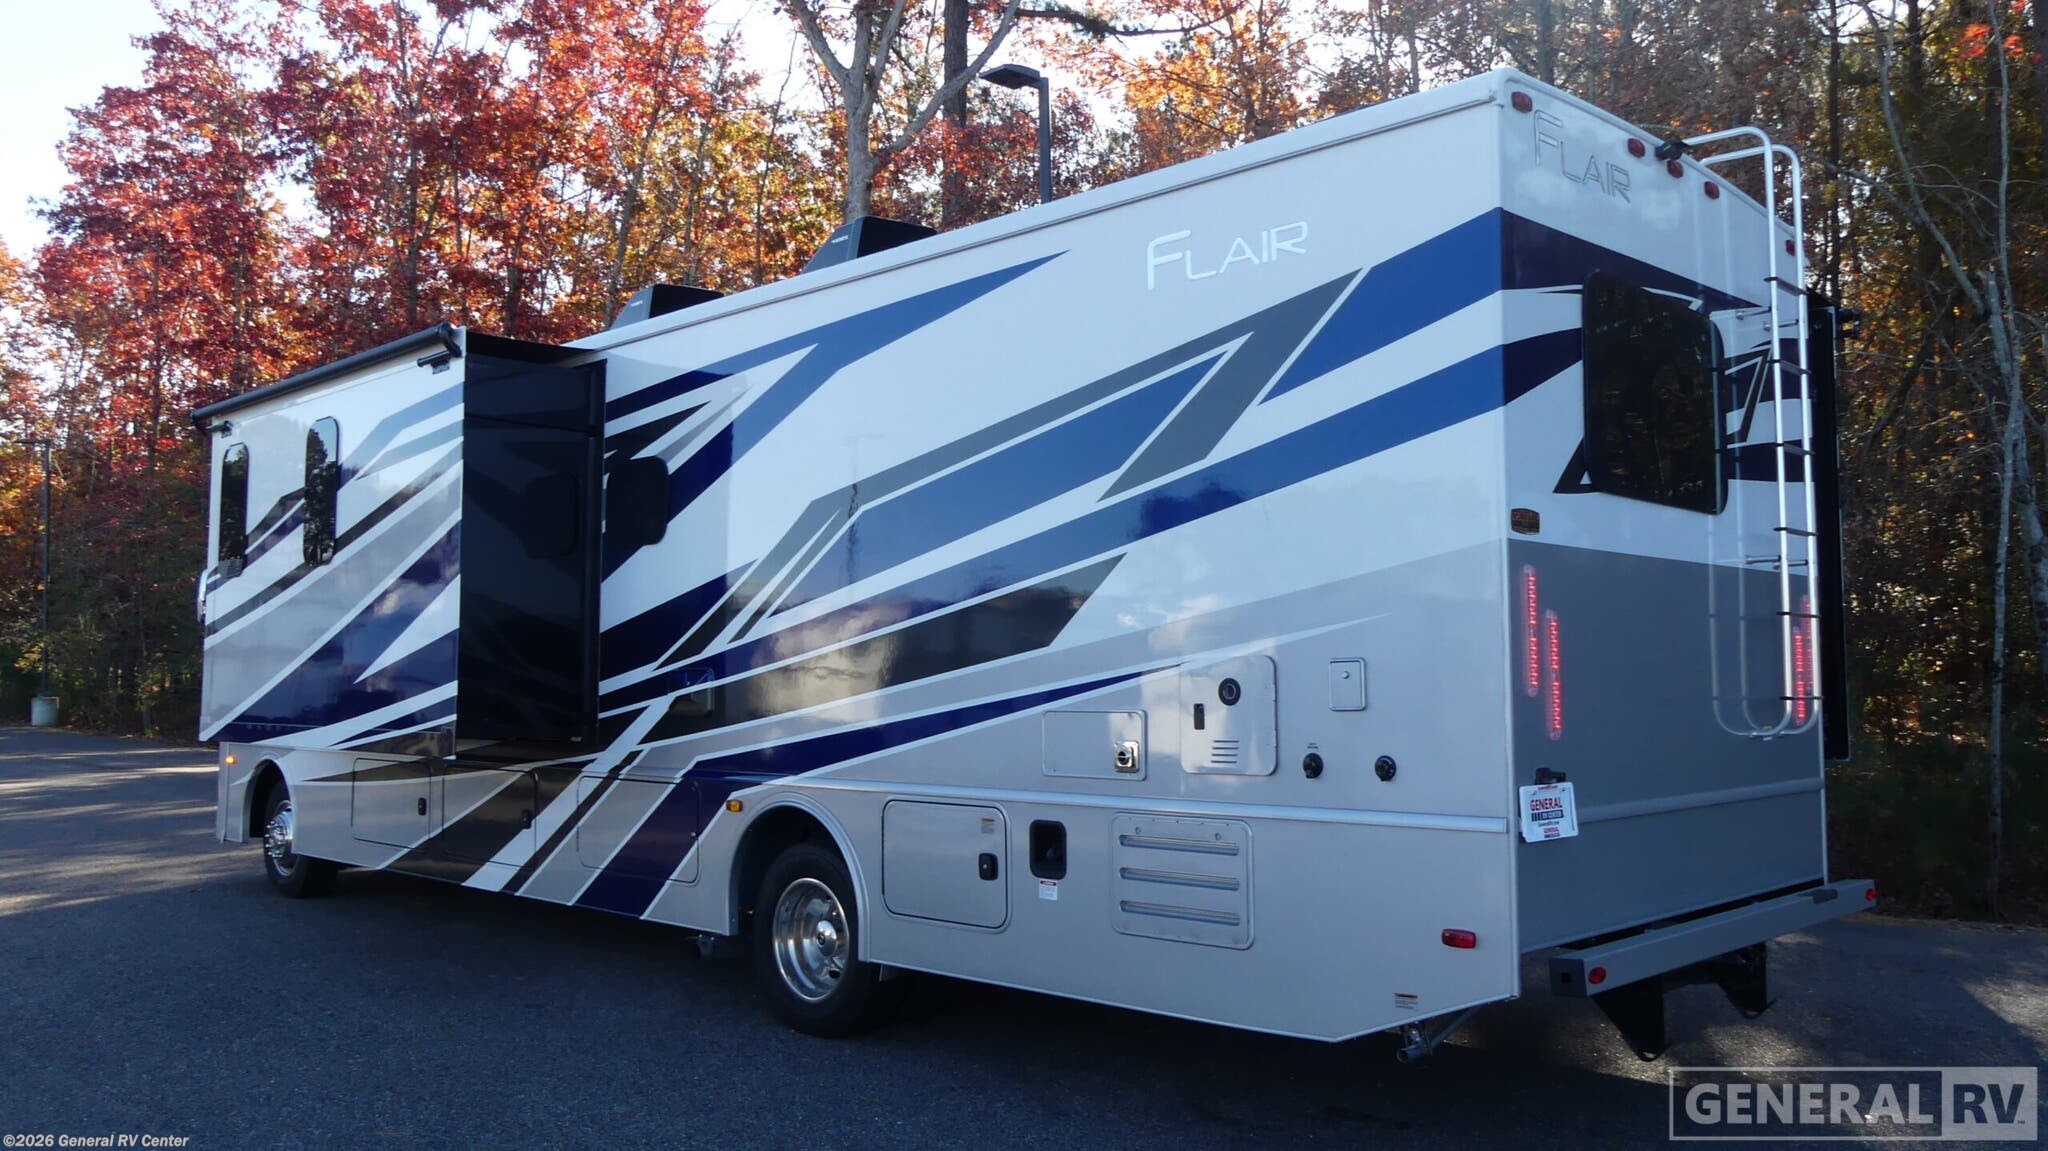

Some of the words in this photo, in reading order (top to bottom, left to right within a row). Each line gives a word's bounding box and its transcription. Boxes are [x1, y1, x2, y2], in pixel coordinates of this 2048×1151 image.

[1534, 110, 1631, 203] FLAIR
[1147, 221, 1307, 290] FLAIR
[1531, 797, 1562, 811] GENERAL
